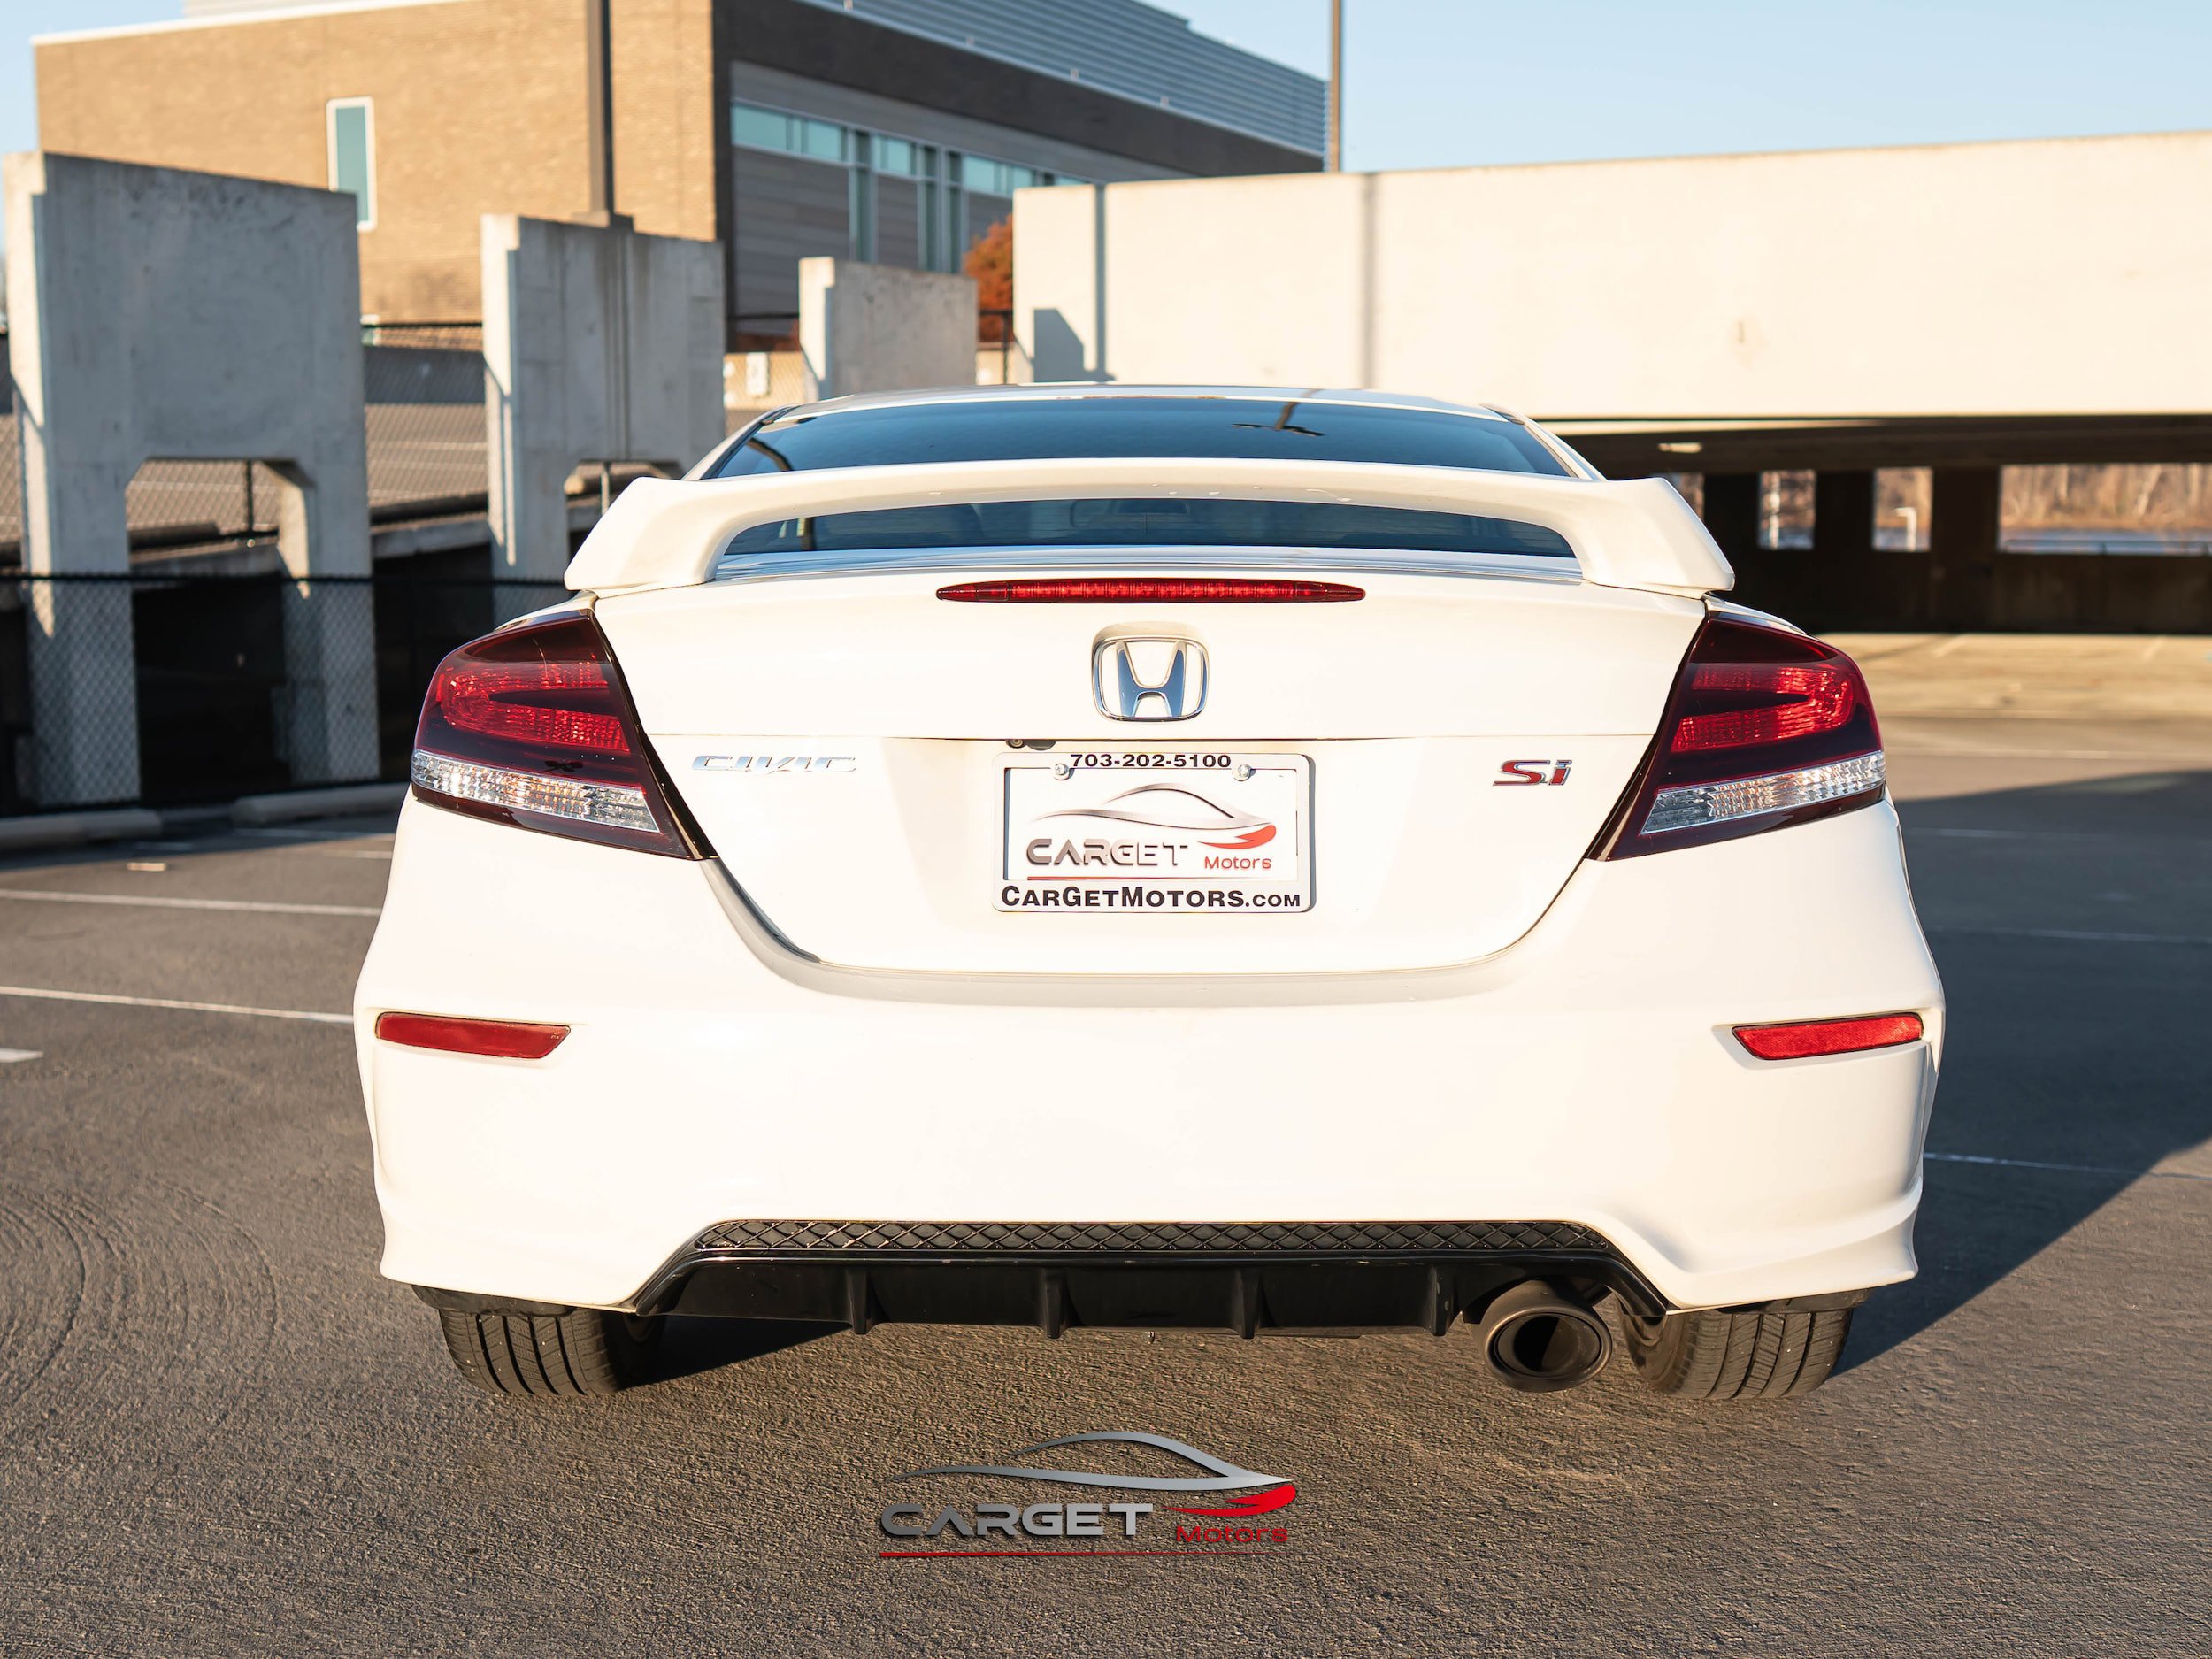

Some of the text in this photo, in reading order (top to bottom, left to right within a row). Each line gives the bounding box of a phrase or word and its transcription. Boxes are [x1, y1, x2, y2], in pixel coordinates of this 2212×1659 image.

[692, 755, 856, 773] CIVIC
[1070, 753, 1232, 768] 703-202-5100
[1493, 759, 1572, 786] Si
[1026, 838, 1271, 870] CARGET Motors
